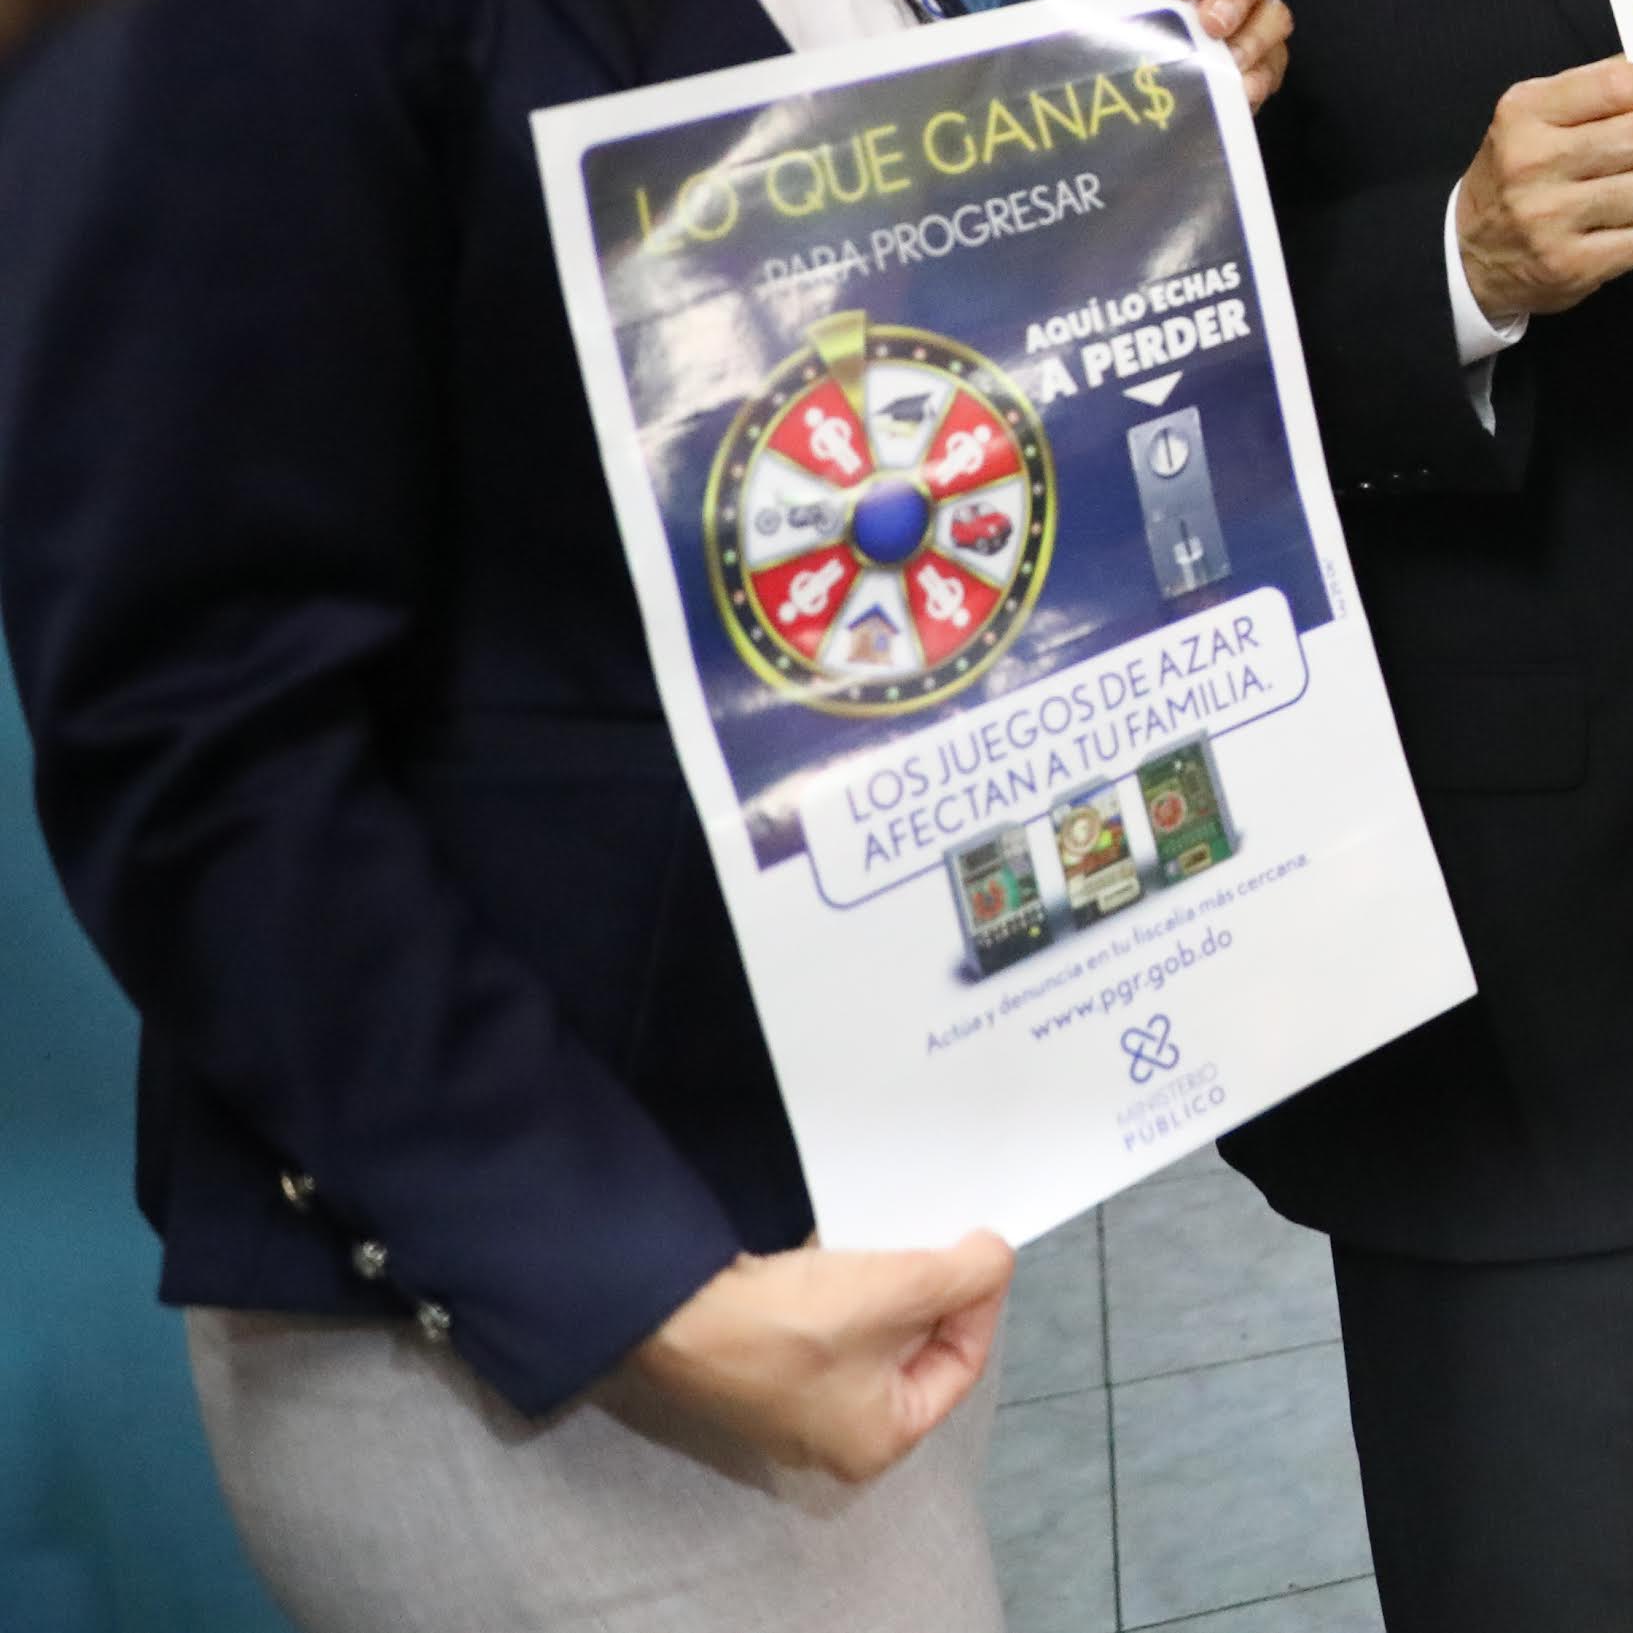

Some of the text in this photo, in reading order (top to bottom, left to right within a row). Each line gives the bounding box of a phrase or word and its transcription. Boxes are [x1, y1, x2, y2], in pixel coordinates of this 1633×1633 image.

[766, 124, 911, 219] QUE
[869, 172, 1104, 271] PROGRESAR
[1039, 298, 1251, 404] A PERDER
[846, 615, 1259, 824] LOS JUEGOS DE AZAR
[864, 760, 1036, 872] AFECTAN
[1046, 749, 1070, 788] A
[1071, 721, 1120, 770] TU
